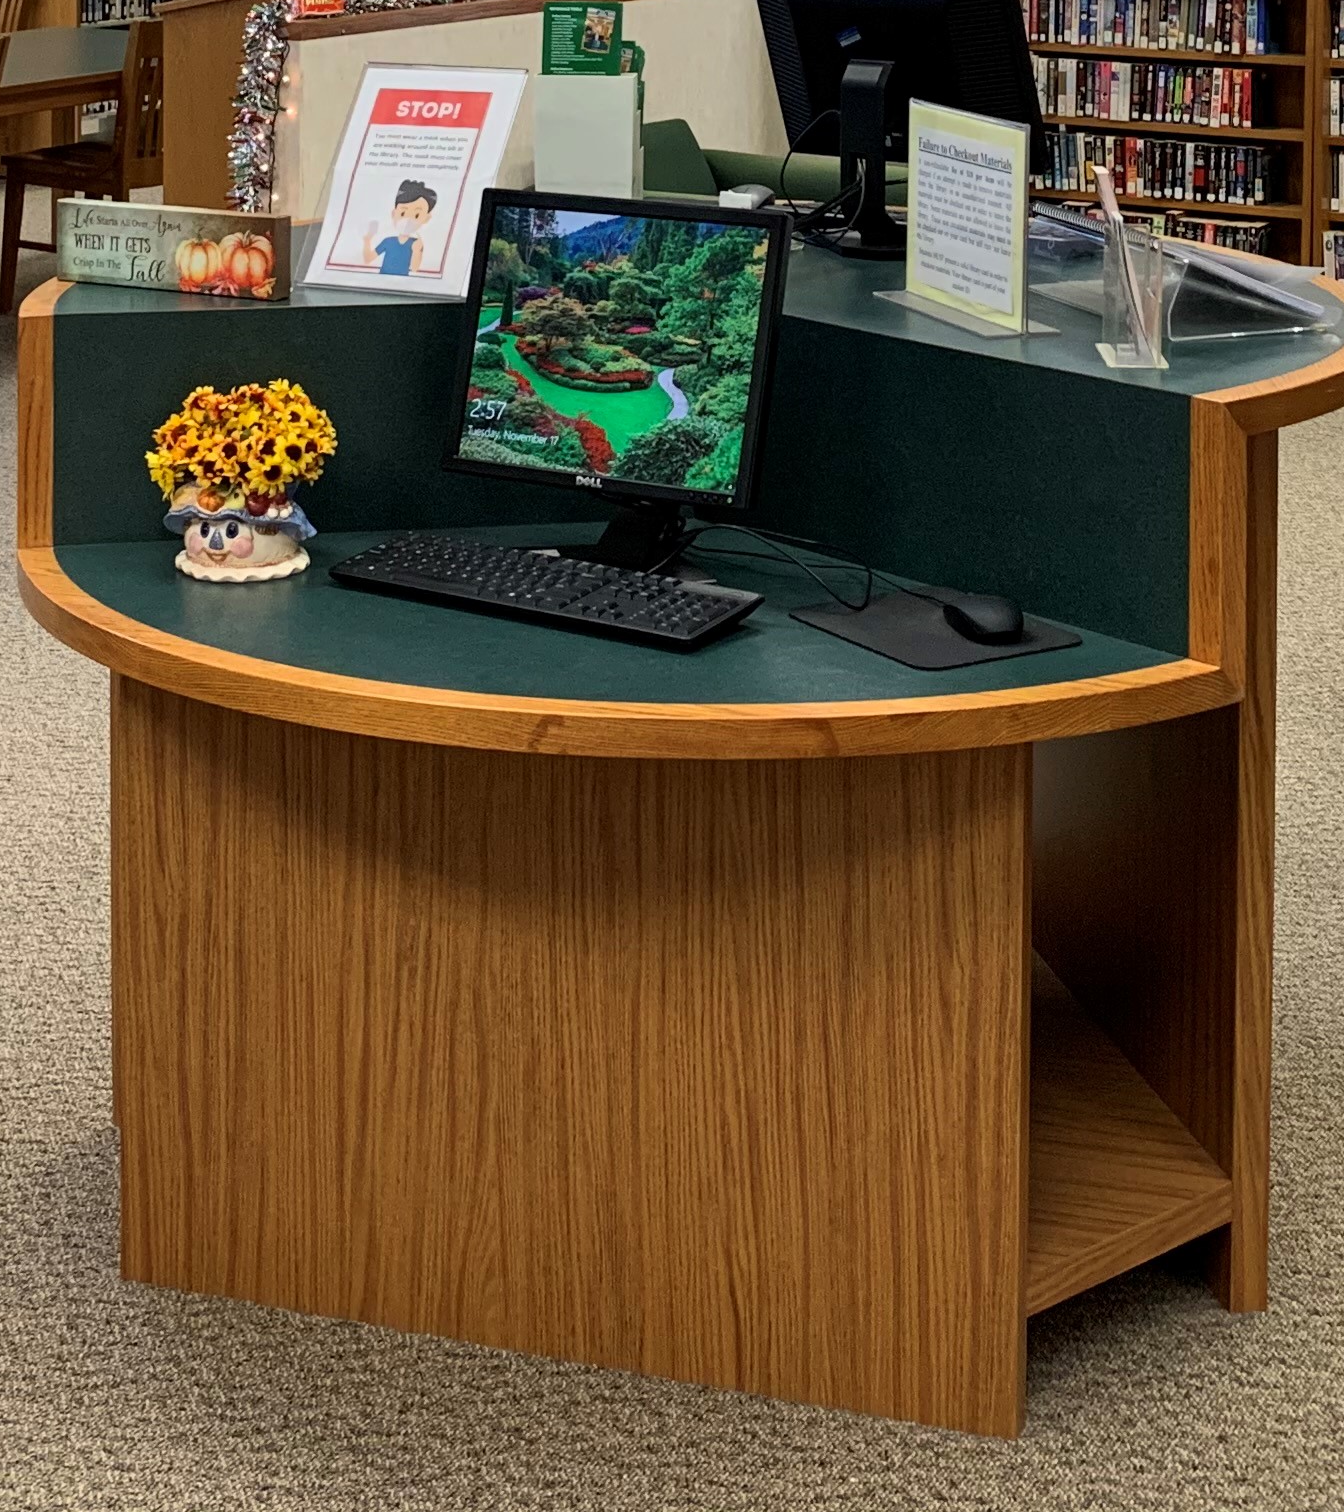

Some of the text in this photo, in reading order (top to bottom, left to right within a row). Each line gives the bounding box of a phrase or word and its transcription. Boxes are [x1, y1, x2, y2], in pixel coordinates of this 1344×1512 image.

[396, 100, 462, 120] STOP!
[918, 136, 1012, 171] Failure to Checkout Materials
[69, 207, 94, 230] Life
[96, 216, 118, 225] Starts
[120, 218, 131, 227] All
[132, 220, 148, 228] Over
[73, 233, 151, 253] WHEN IT GETS
[73, 256, 95, 269] Crisp
[96, 258, 104, 268] In
[106, 260, 121, 270] The
[469, 398, 507, 420] 2:57
[468, 425, 560, 446] Tuesday, November 17
[575, 475, 602, 488] DELL
